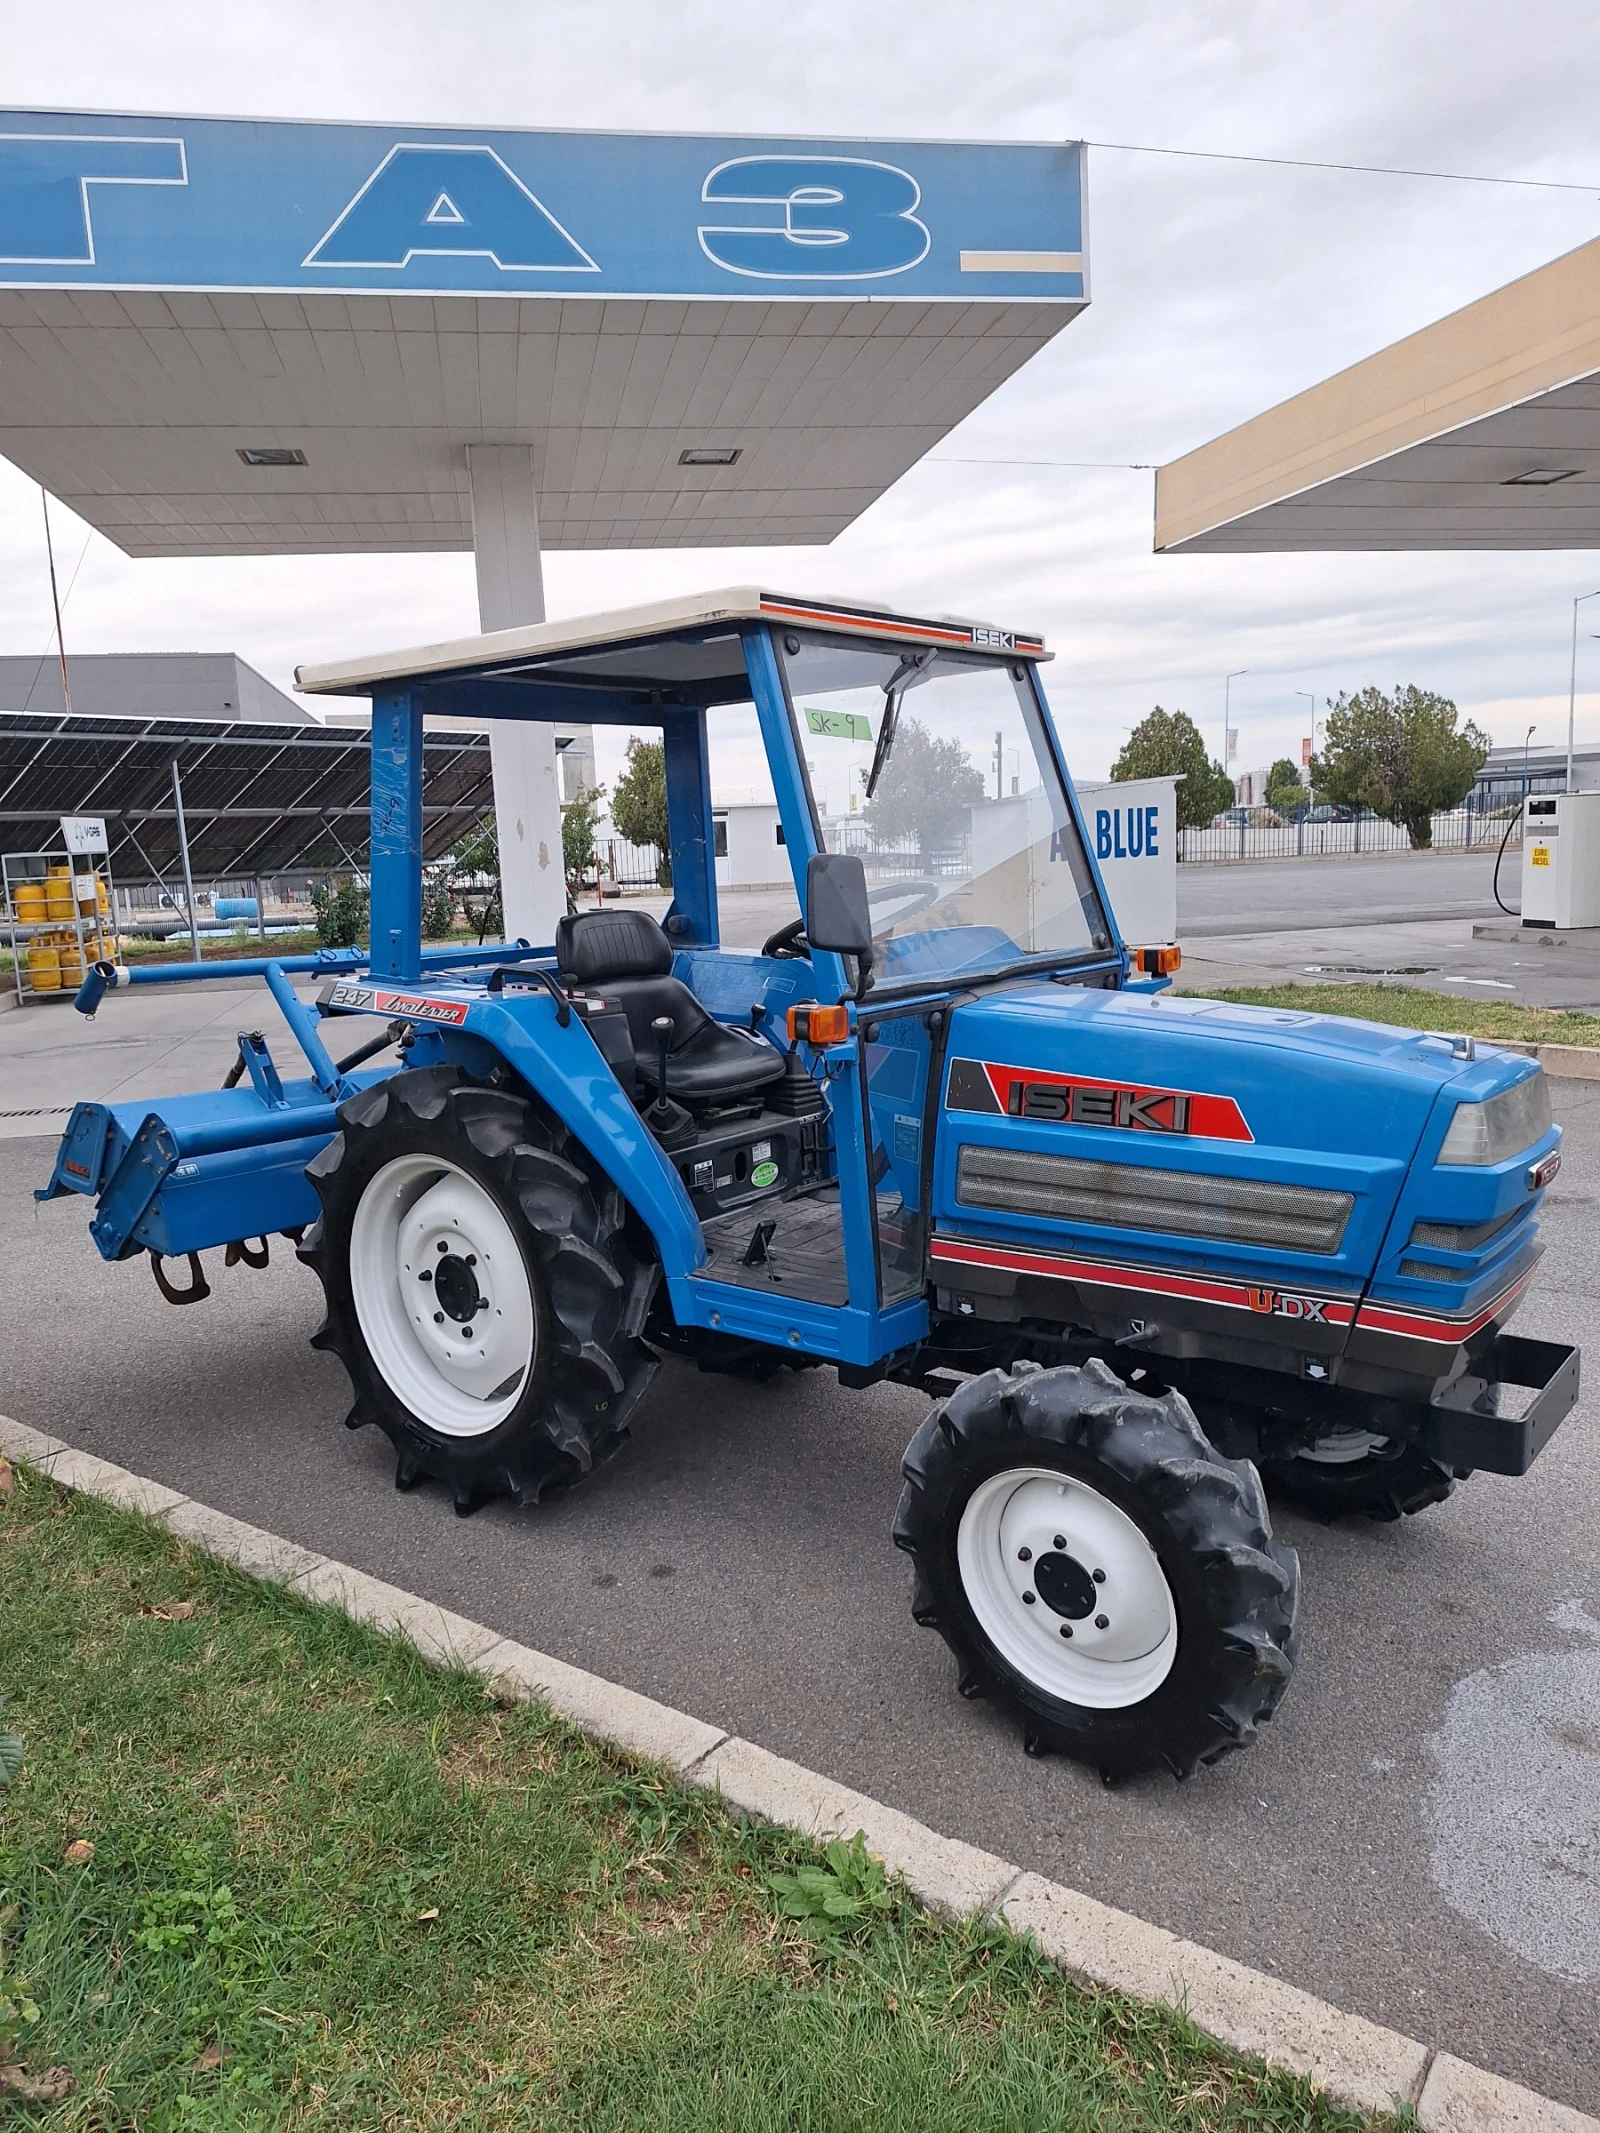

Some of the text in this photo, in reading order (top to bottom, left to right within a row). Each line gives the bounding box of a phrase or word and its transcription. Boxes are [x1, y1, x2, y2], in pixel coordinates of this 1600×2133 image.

[972, 627, 1016, 649] ISEKI
[811, 712, 856, 744] SK-9
[1096, 806, 1159, 859] BLUE
[1532, 857, 1549, 866] DIESEL
[1534, 848, 1548, 857] EURO
[331, 987, 372, 1007] 247
[1008, 1080, 1191, 1135] ISEKI
[1245, 1286, 1328, 1324] U-DX
